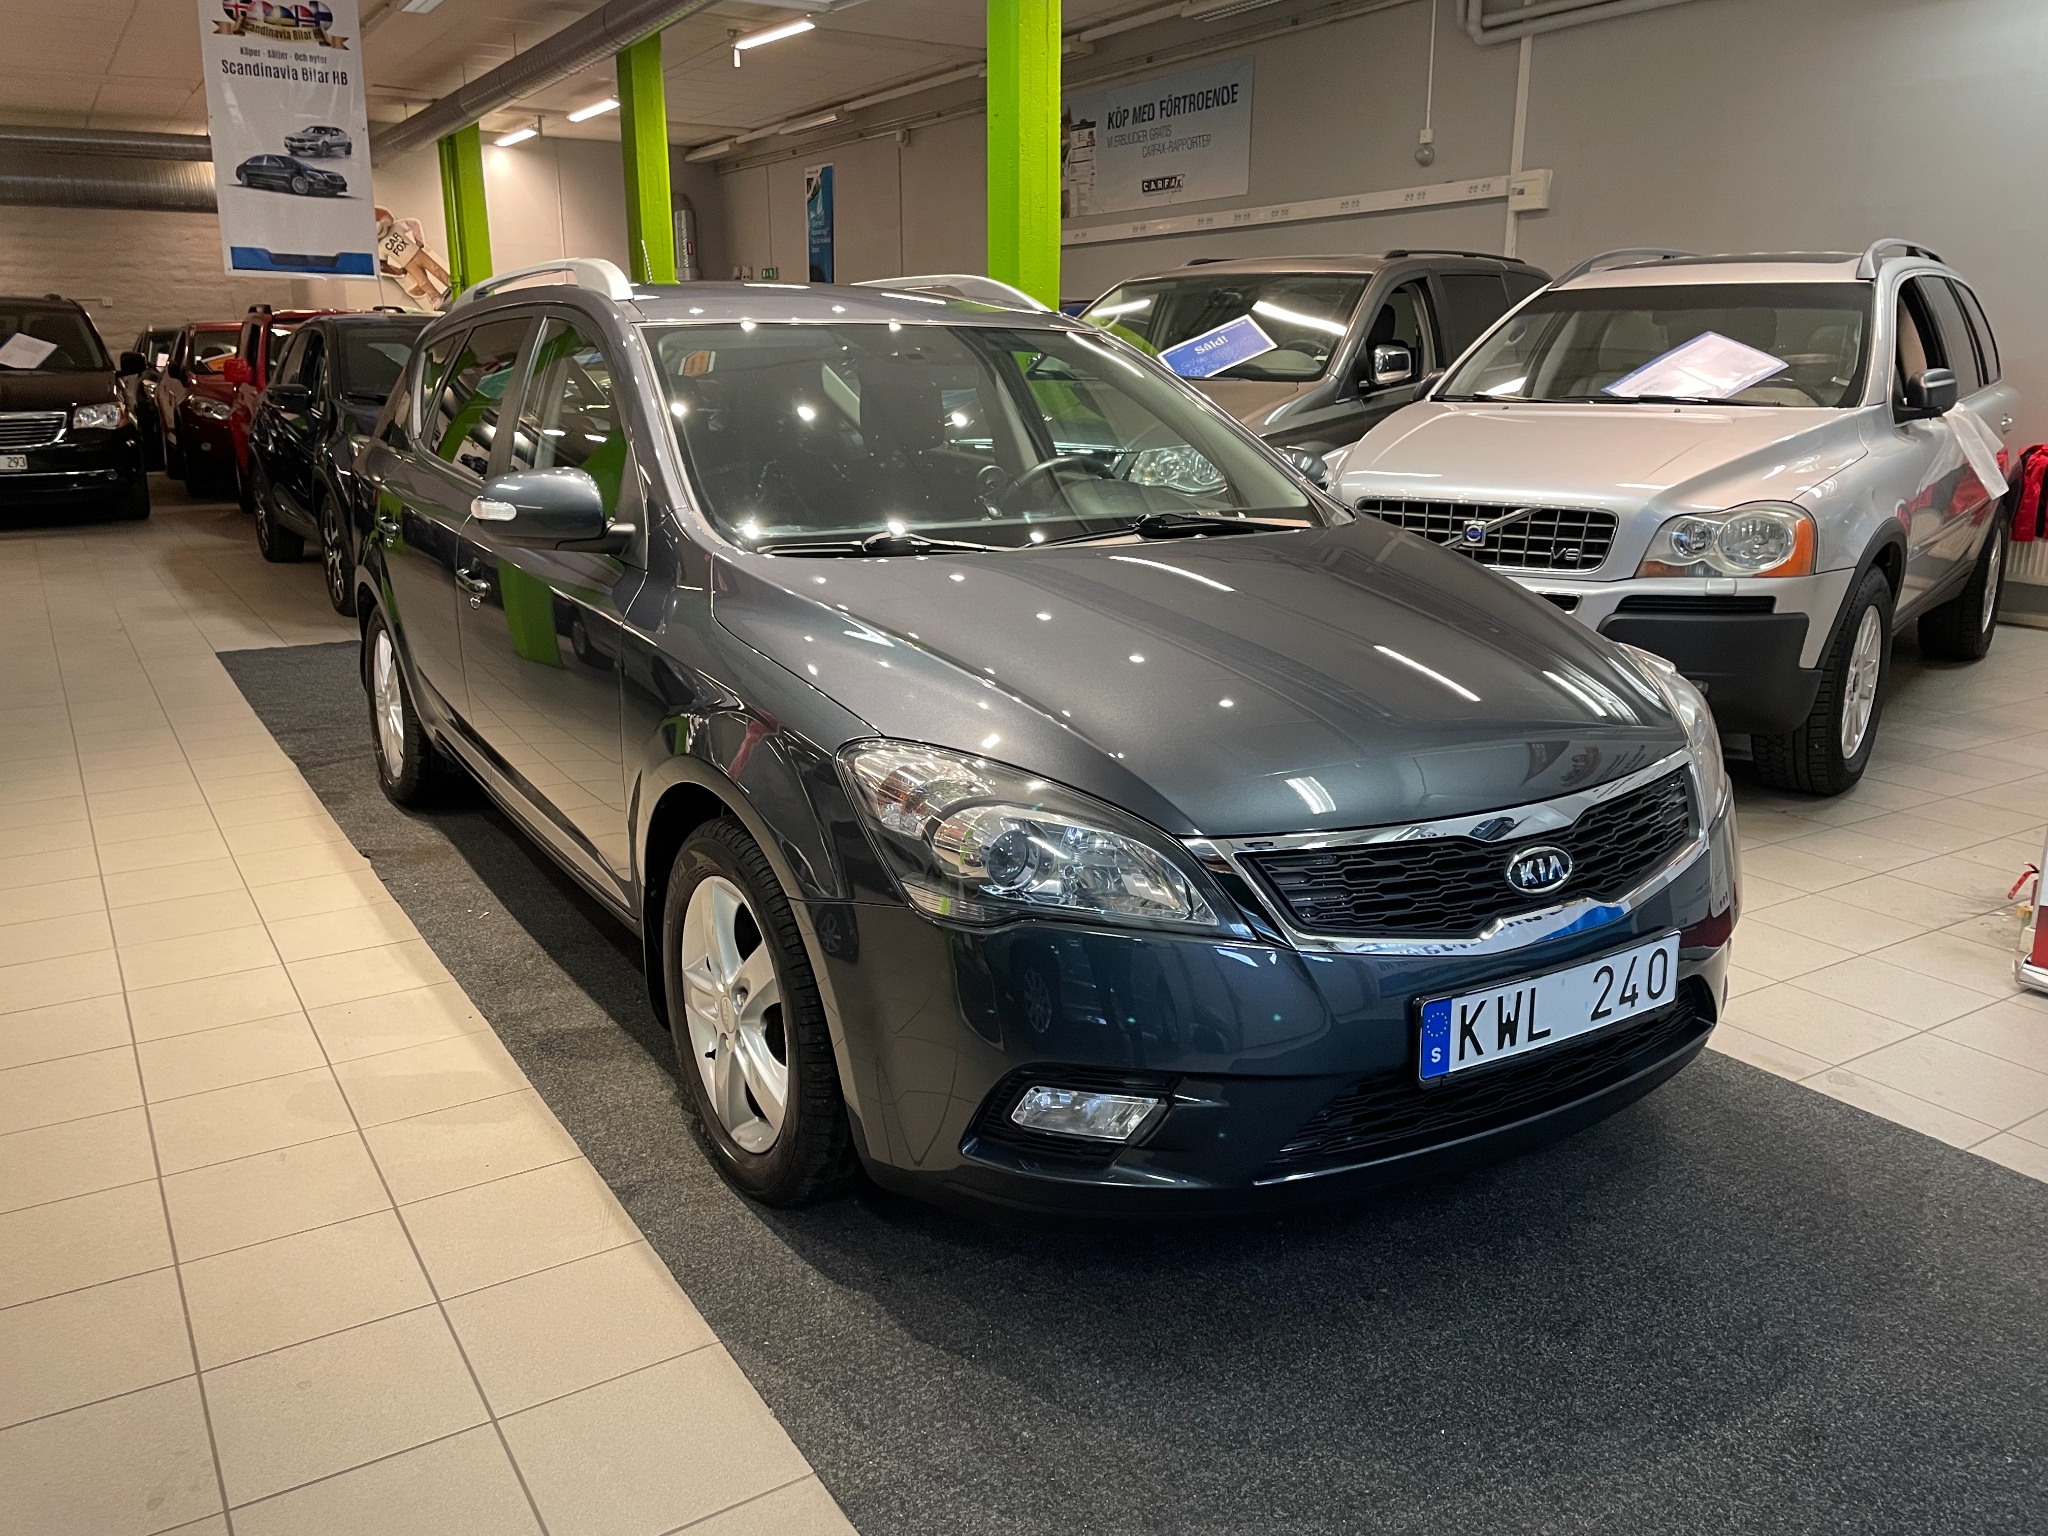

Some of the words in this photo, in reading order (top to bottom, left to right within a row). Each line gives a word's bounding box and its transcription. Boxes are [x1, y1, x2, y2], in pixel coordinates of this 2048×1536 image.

[221, 59, 299, 81] Scandinavia
[301, 67, 329, 84] Bilar
[333, 70, 348, 86] HB
[1107, 106, 1130, 130] KÖP
[1132, 102, 1155, 125] MED
[1159, 83, 1239, 119] FÖRTROENDE
[385, 232, 401, 251] CAR
[392, 239, 409, 257] FOX
[1194, 335, 1229, 355] Såld!
[7, 456, 26, 468] 293
[1517, 855, 1564, 887] KIA
[1431, 1047, 1442, 1064] S
[1458, 987, 1551, 1062] KWL
[1590, 947, 1668, 1022] 240
